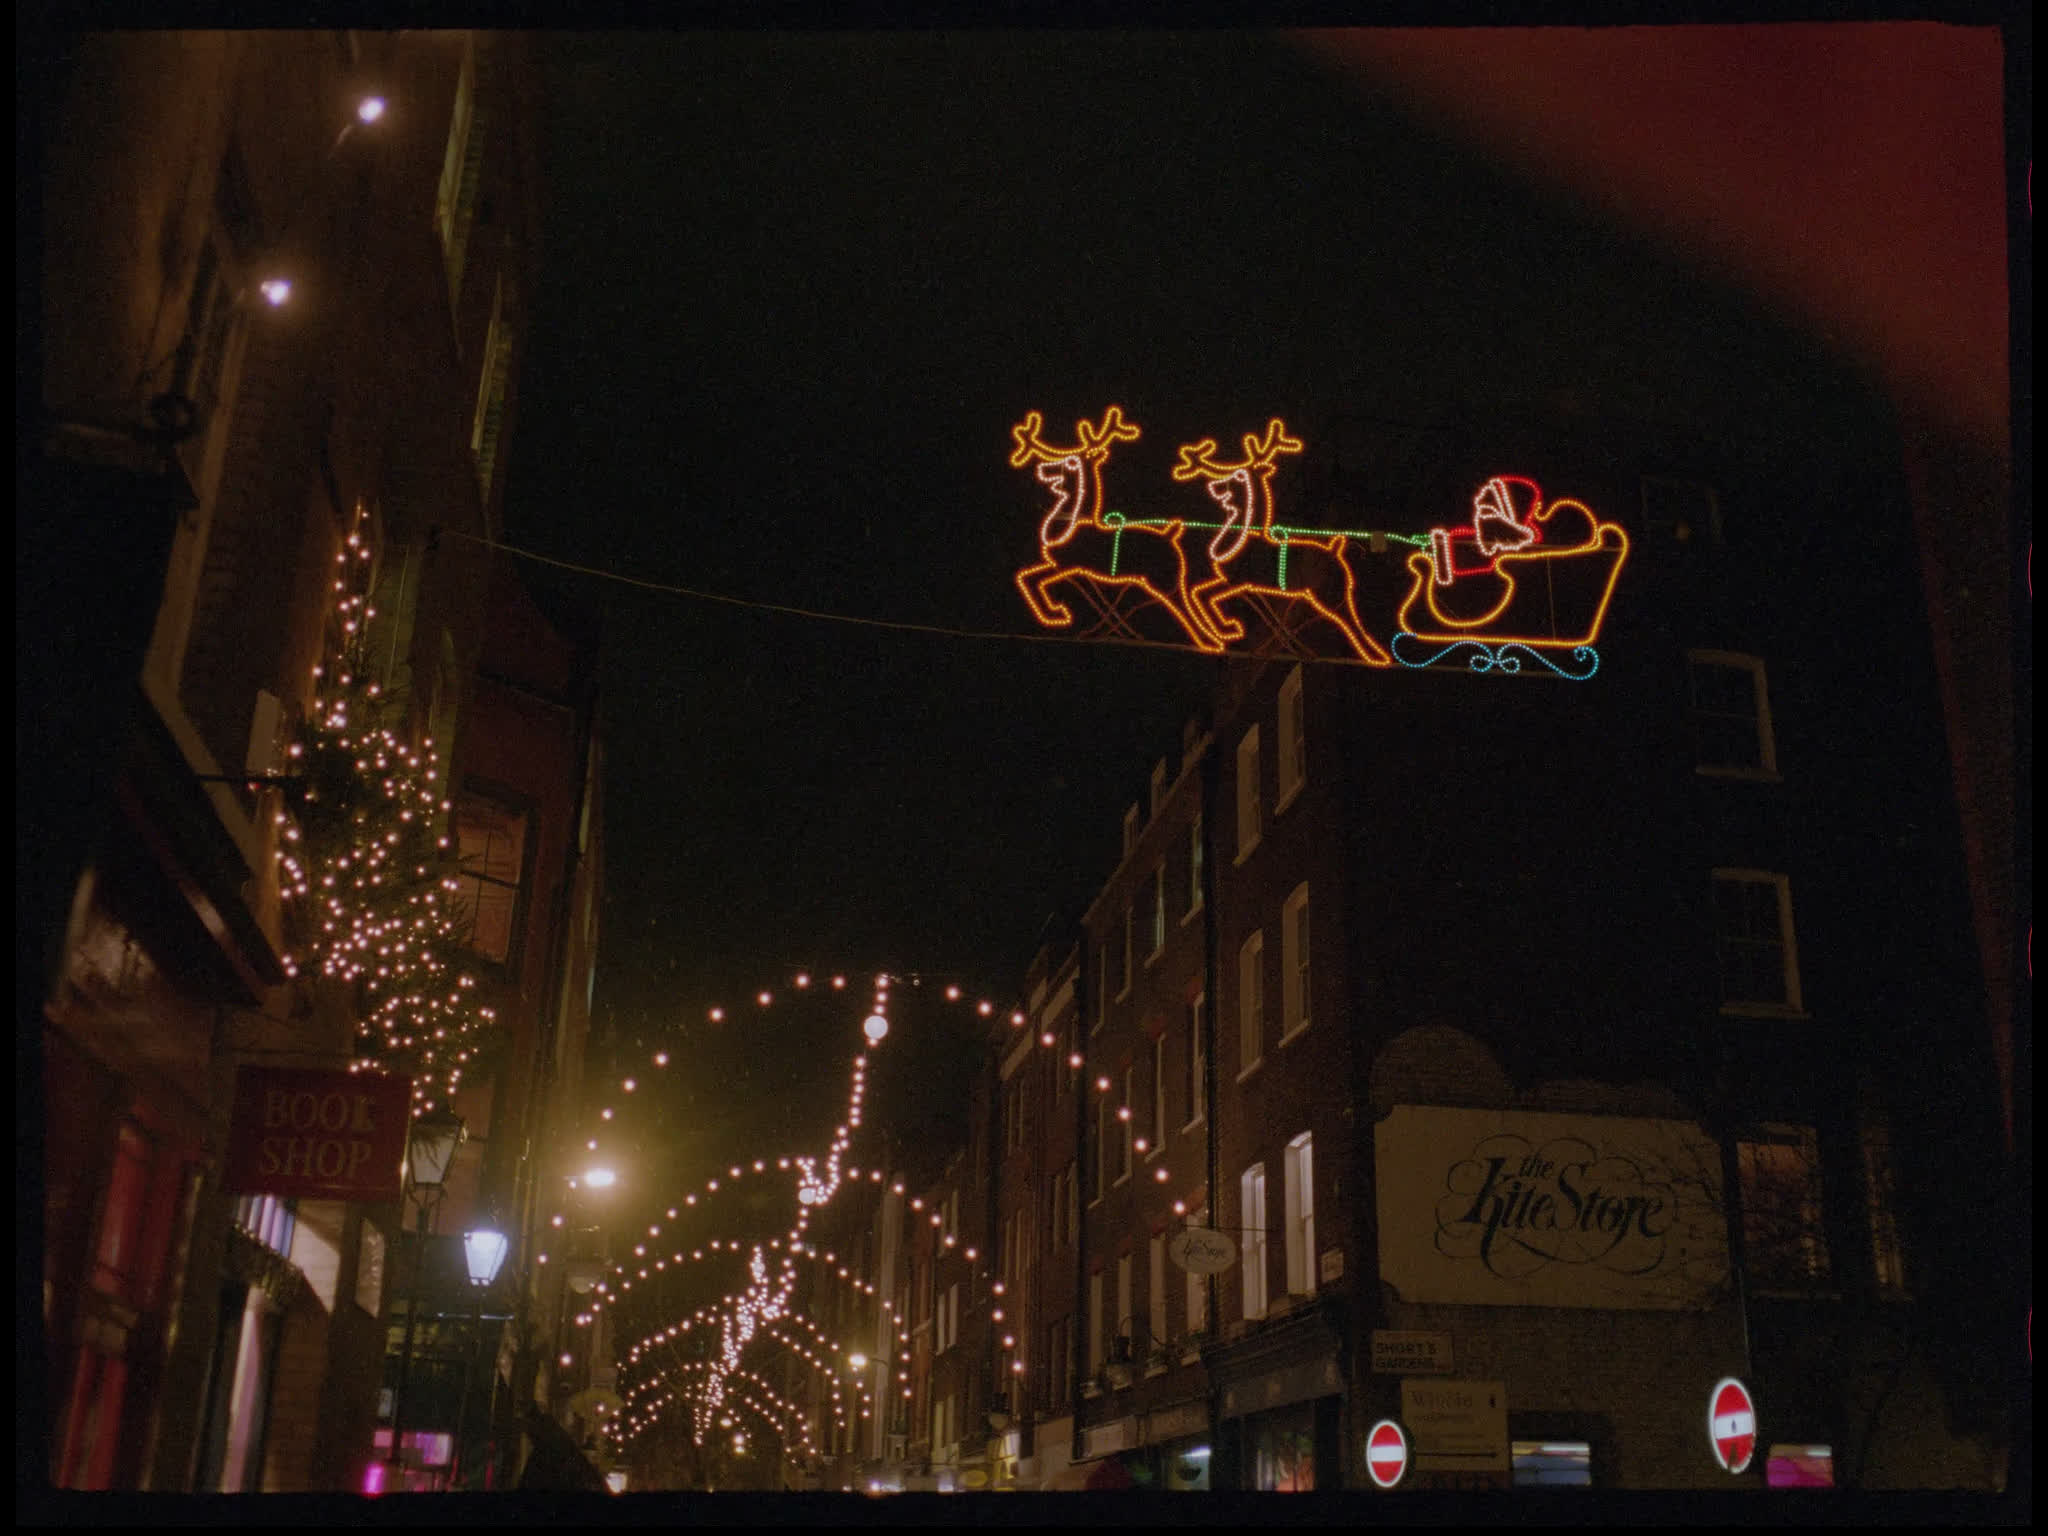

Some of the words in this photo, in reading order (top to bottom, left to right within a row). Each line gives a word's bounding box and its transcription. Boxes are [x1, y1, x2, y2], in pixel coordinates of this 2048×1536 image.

[264, 1089, 376, 1132] BOOK
[261, 1138, 372, 1177] SHOP
[1518, 1153, 1555, 1179] the
[1556, 1162, 1666, 1240] Store
